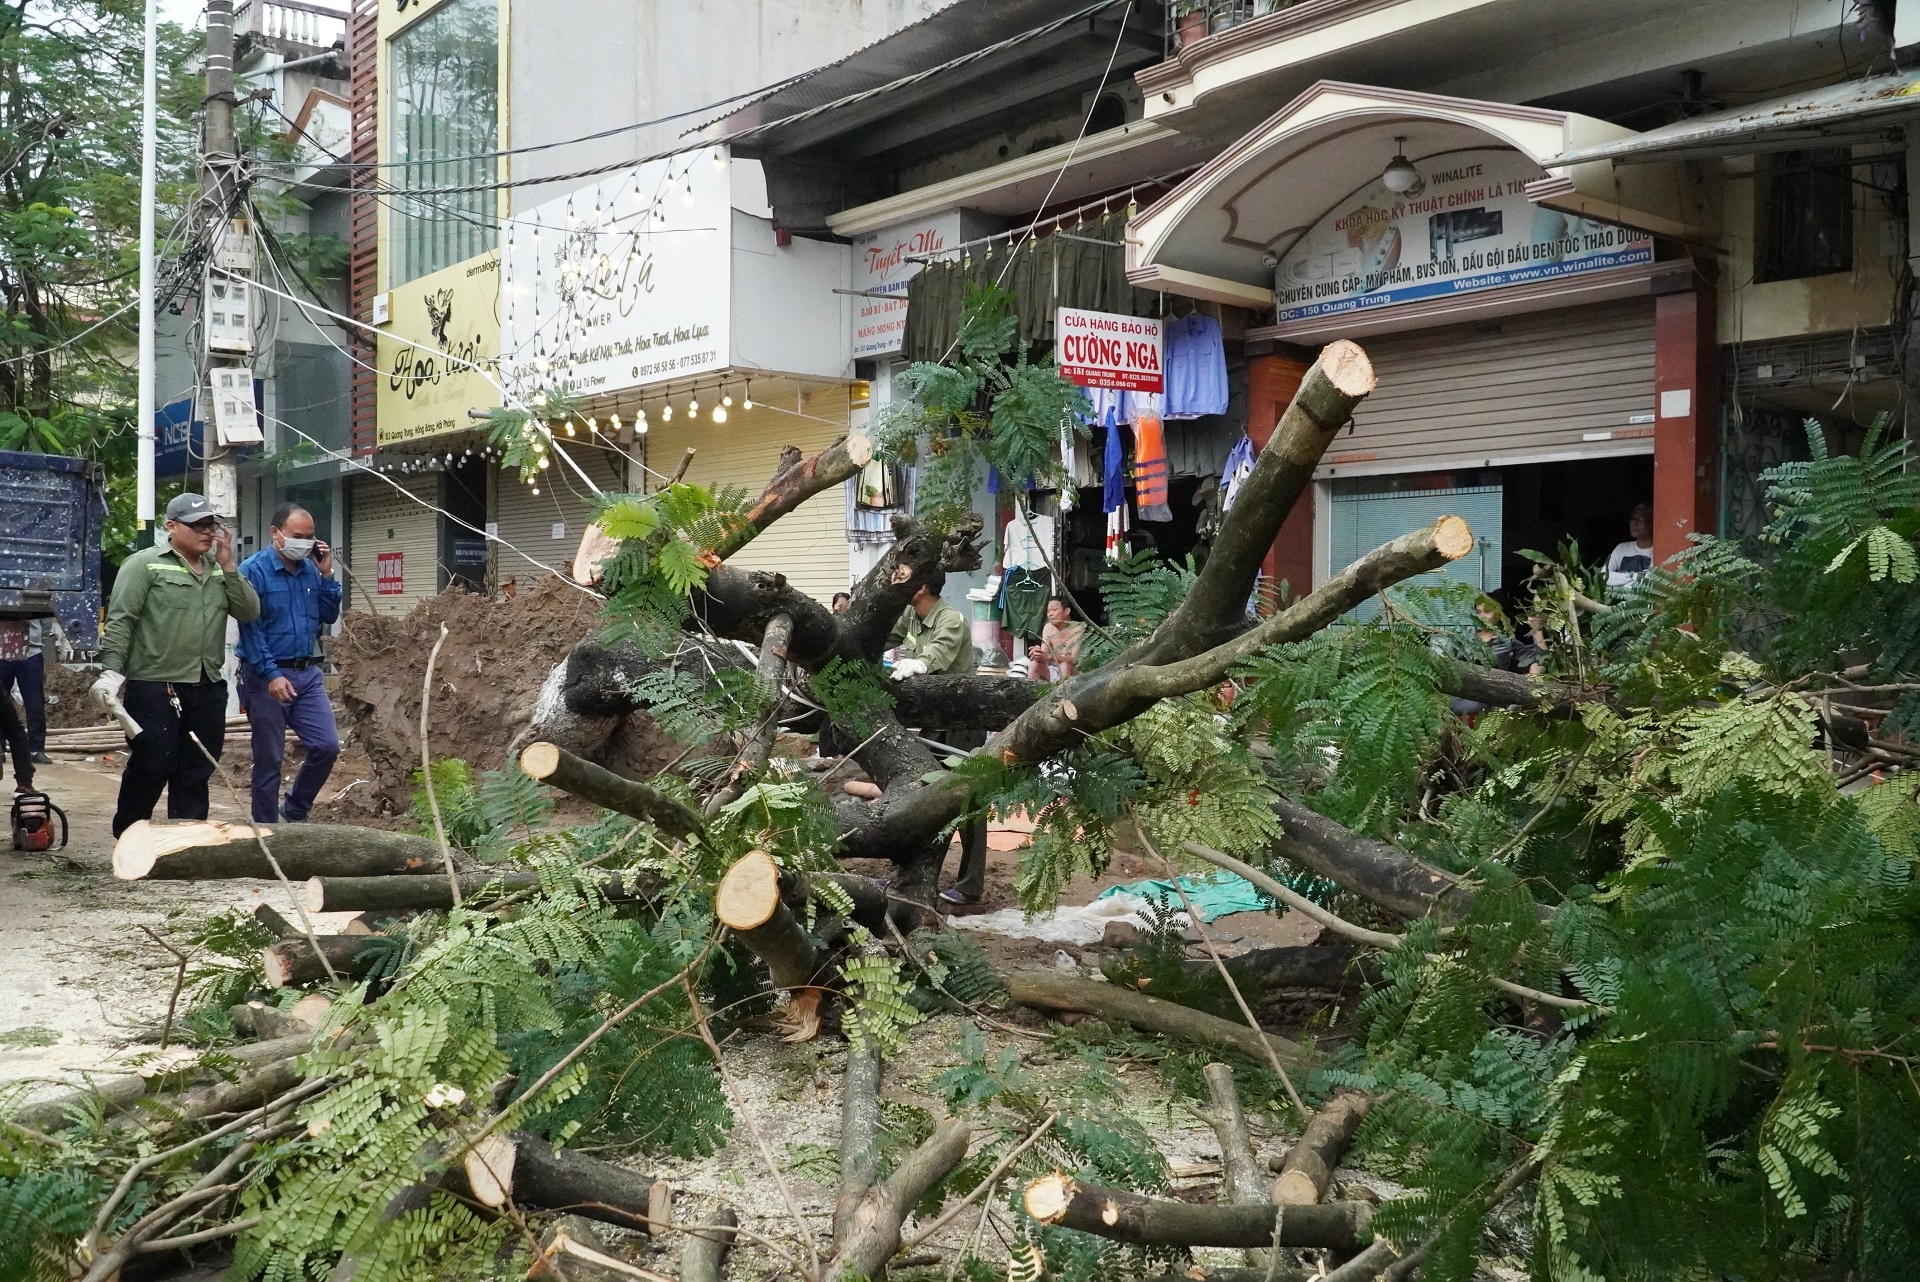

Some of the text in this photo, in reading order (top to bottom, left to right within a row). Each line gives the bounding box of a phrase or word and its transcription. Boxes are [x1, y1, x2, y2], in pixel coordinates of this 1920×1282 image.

[1432, 164, 1483, 184] WINALITE
[1335, 215, 1363, 232] KHOA
[1366, 210, 1388, 227] HỌC
[1409, 196, 1444, 213] THUẬT
[1448, 187, 1484, 207] CHÍNH
[1489, 182, 1503, 198] LÀ
[1507, 178, 1535, 195] TÌN
[1279, 285, 1313, 304] CHUYÊN
[1315, 282, 1340, 298] CUNG
[1487, 248, 1504, 269] GỘI
[1508, 241, 1529, 263] ĐẦU
[1533, 243, 1556, 259] ĐEN
[1583, 226, 1613, 250] THẢO
[1302, 305, 1320, 315] 150
[1322, 299, 1357, 313] Quang
[1359, 294, 1391, 307] Trung
[1453, 276, 1506, 291] Website:
[1510, 250, 1650, 282] www.vn.winalite.com
[635, 334, 651, 352] Hoa
[673, 325, 690, 344] Hoa
[1065, 312, 1158, 340] CỬA HÀNG BẢO HỘ
[1064, 331, 1159, 370] CƯỜNG NGA
[390, 339, 440, 400] Hoa
[590, 376, 606, 386] Flower
[680, 355, 690, 368] 077
[1073, 367, 1085, 376] 151
[164, 420, 188, 446] NCB
